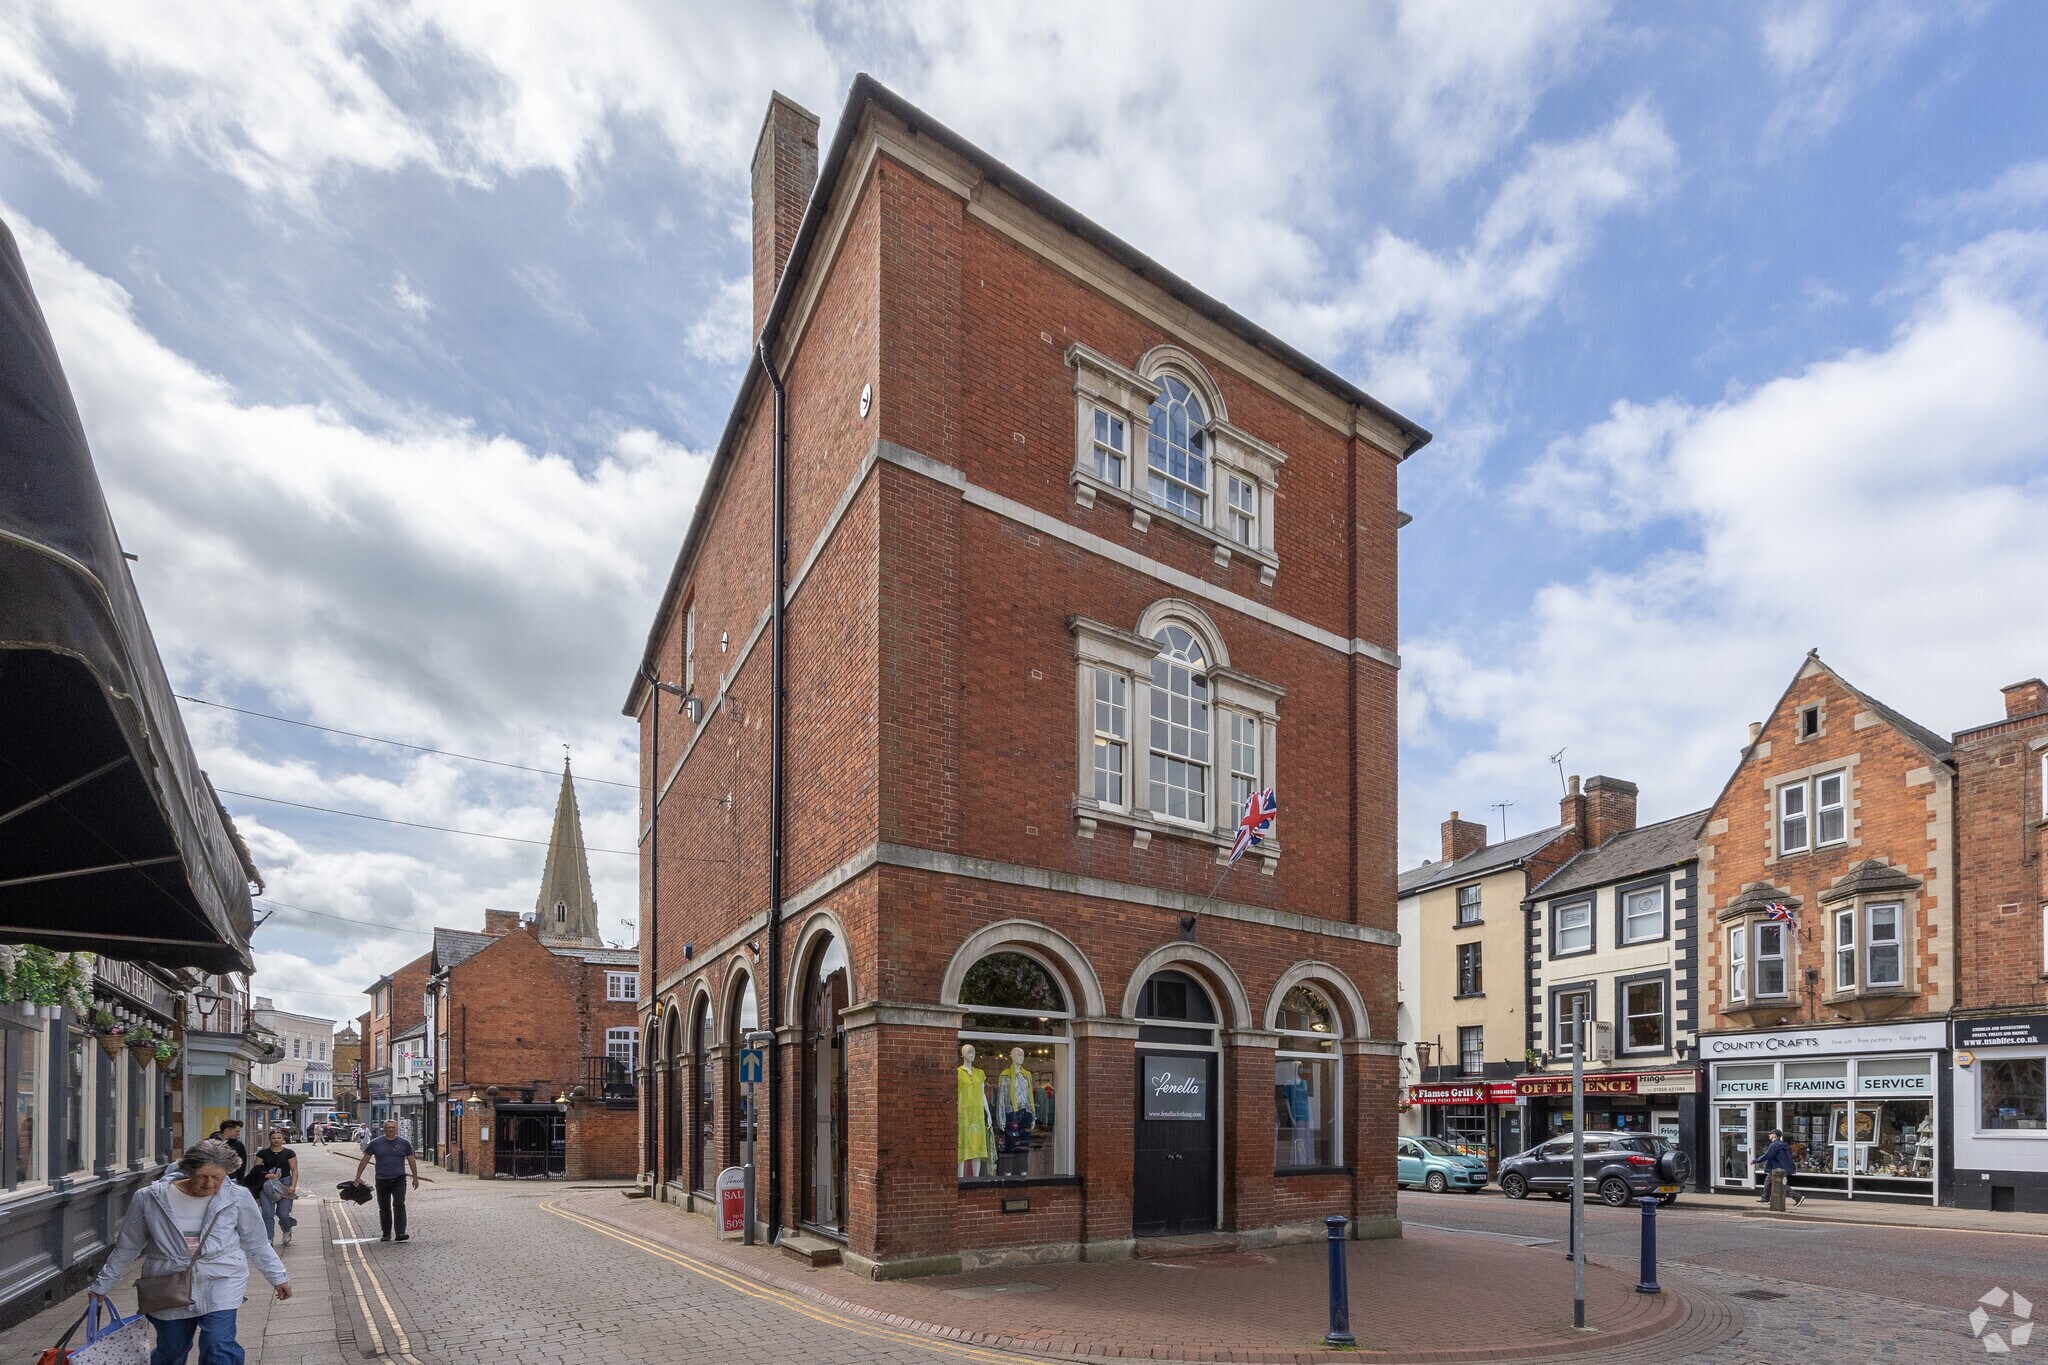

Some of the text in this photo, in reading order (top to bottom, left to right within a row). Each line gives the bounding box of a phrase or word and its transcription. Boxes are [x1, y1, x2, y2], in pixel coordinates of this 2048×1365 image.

[1963, 1035, 2038, 1046] www.usabites.co.uk
[1521, 1080, 1632, 1094] OFF LIENCE
[1720, 1078, 1924, 1092] PICTURE FRAMING SERVICE
[1418, 1087, 1474, 1098] Flames Grill
[1660, 1128, 1680, 1136] Fring
[724, 1190, 744, 1200] SAL
